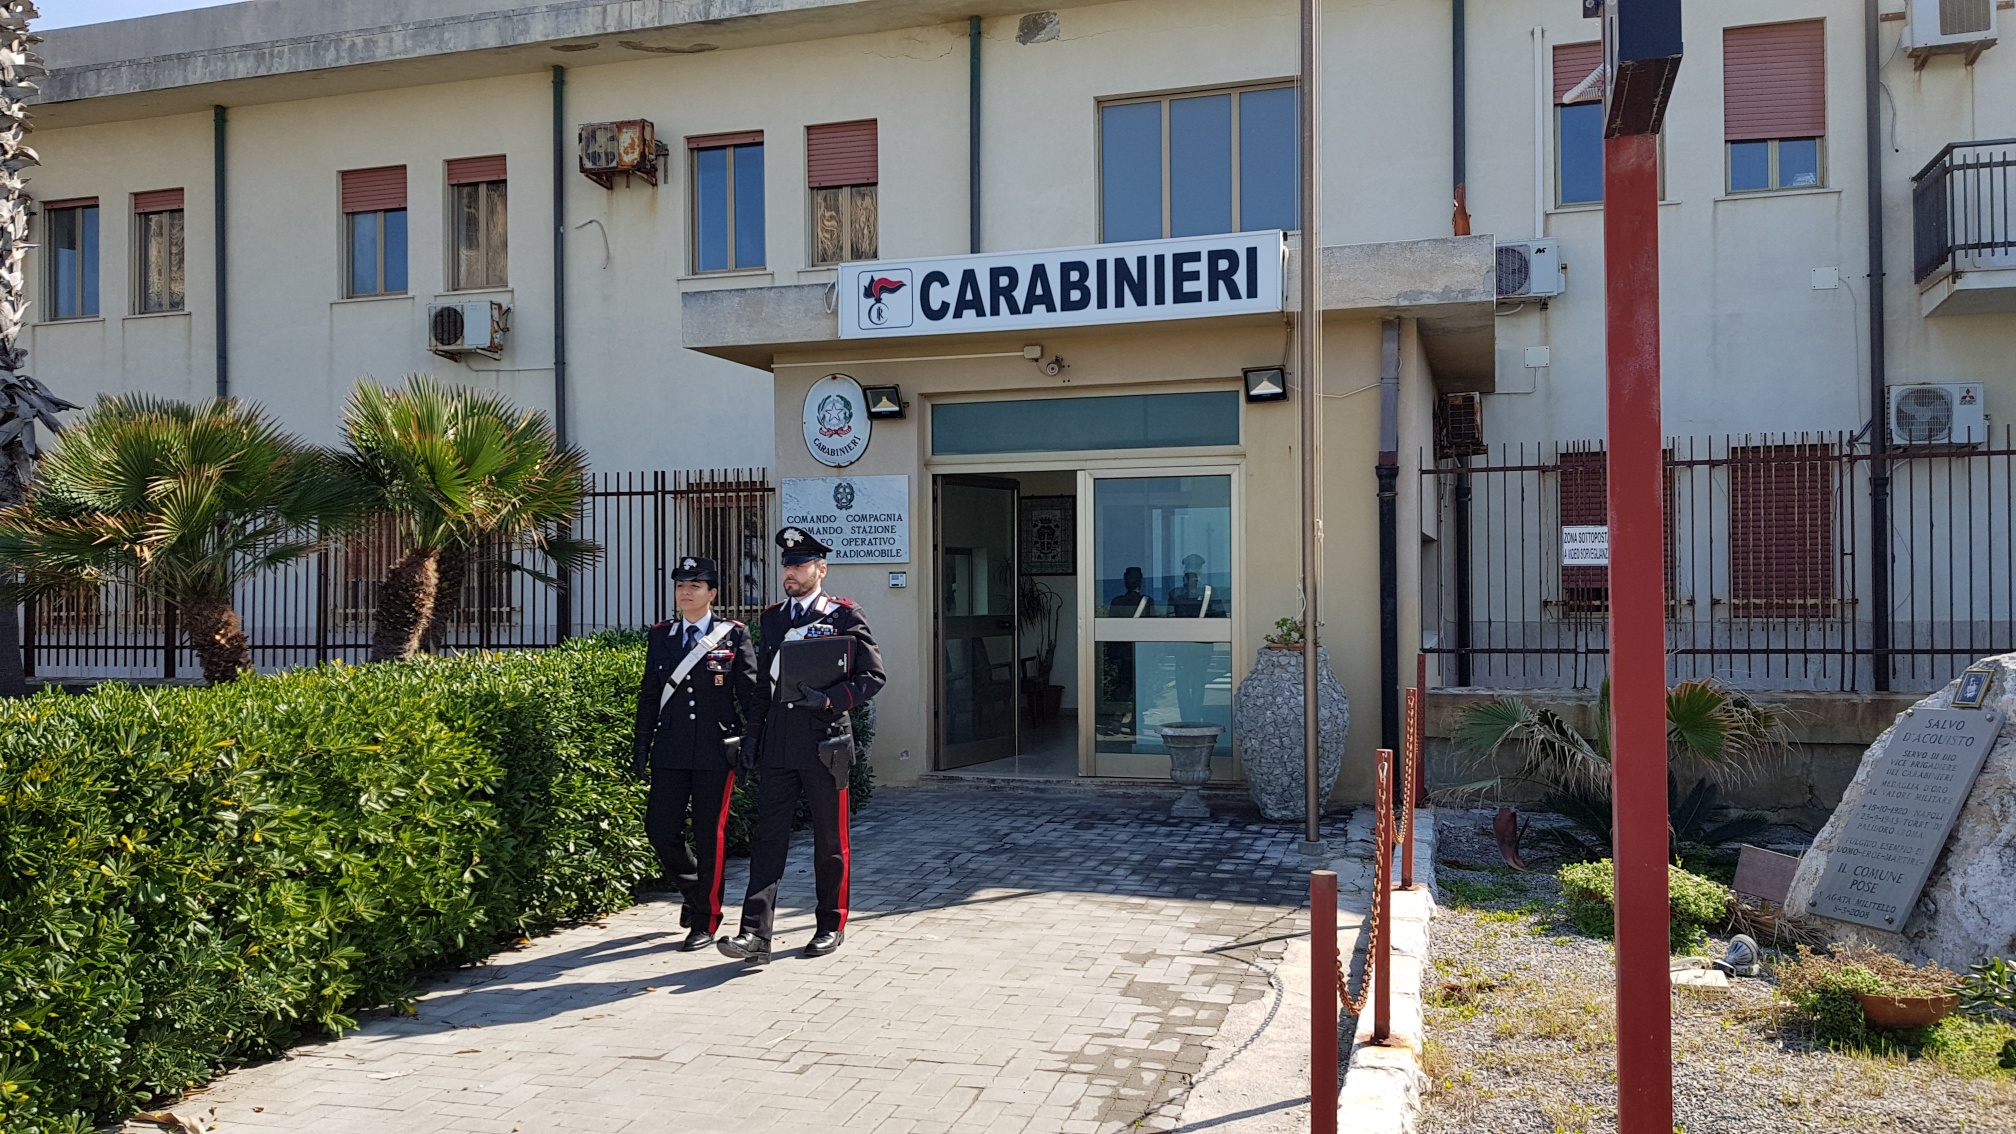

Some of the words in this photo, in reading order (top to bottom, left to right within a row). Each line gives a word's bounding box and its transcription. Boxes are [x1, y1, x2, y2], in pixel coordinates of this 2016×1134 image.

[919, 246, 1258, 321] CARABINIERI
[813, 435, 861, 457] CARABINIERI
[786, 514, 837, 524] COMANDO
[846, 513, 903, 523] COMPAGNIA
[800, 526, 843, 535] OMANDO
[850, 525, 897, 534] STAZIONE
[841, 537, 896, 547] OPERATIVO
[1564, 532, 1578, 544] ZONA
[1578, 531, 1608, 544] SOTTOPOST
[835, 549, 902, 558] RADIOMOBILE
[1924, 718, 1966, 731] SALVO
[1902, 732, 1975, 747] D'ACQUISTO
[1902, 750, 1928, 759] SERVO
[1930, 752, 1940, 760] DI
[1942, 753, 1957, 761] DIO
[1890, 758, 1907, 767] VICE
[1901, 769, 1954, 782] CARABINIERI
[1913, 810, 1945, 821] NAPOLI
[1837, 862, 1848, 874] IL
[1853, 865, 1906, 884] COMUNE
[1849, 879, 1879, 894] POSE
[1825, 892, 1852, 905] AGATA
[1855, 898, 1897, 914] MILITELLO
